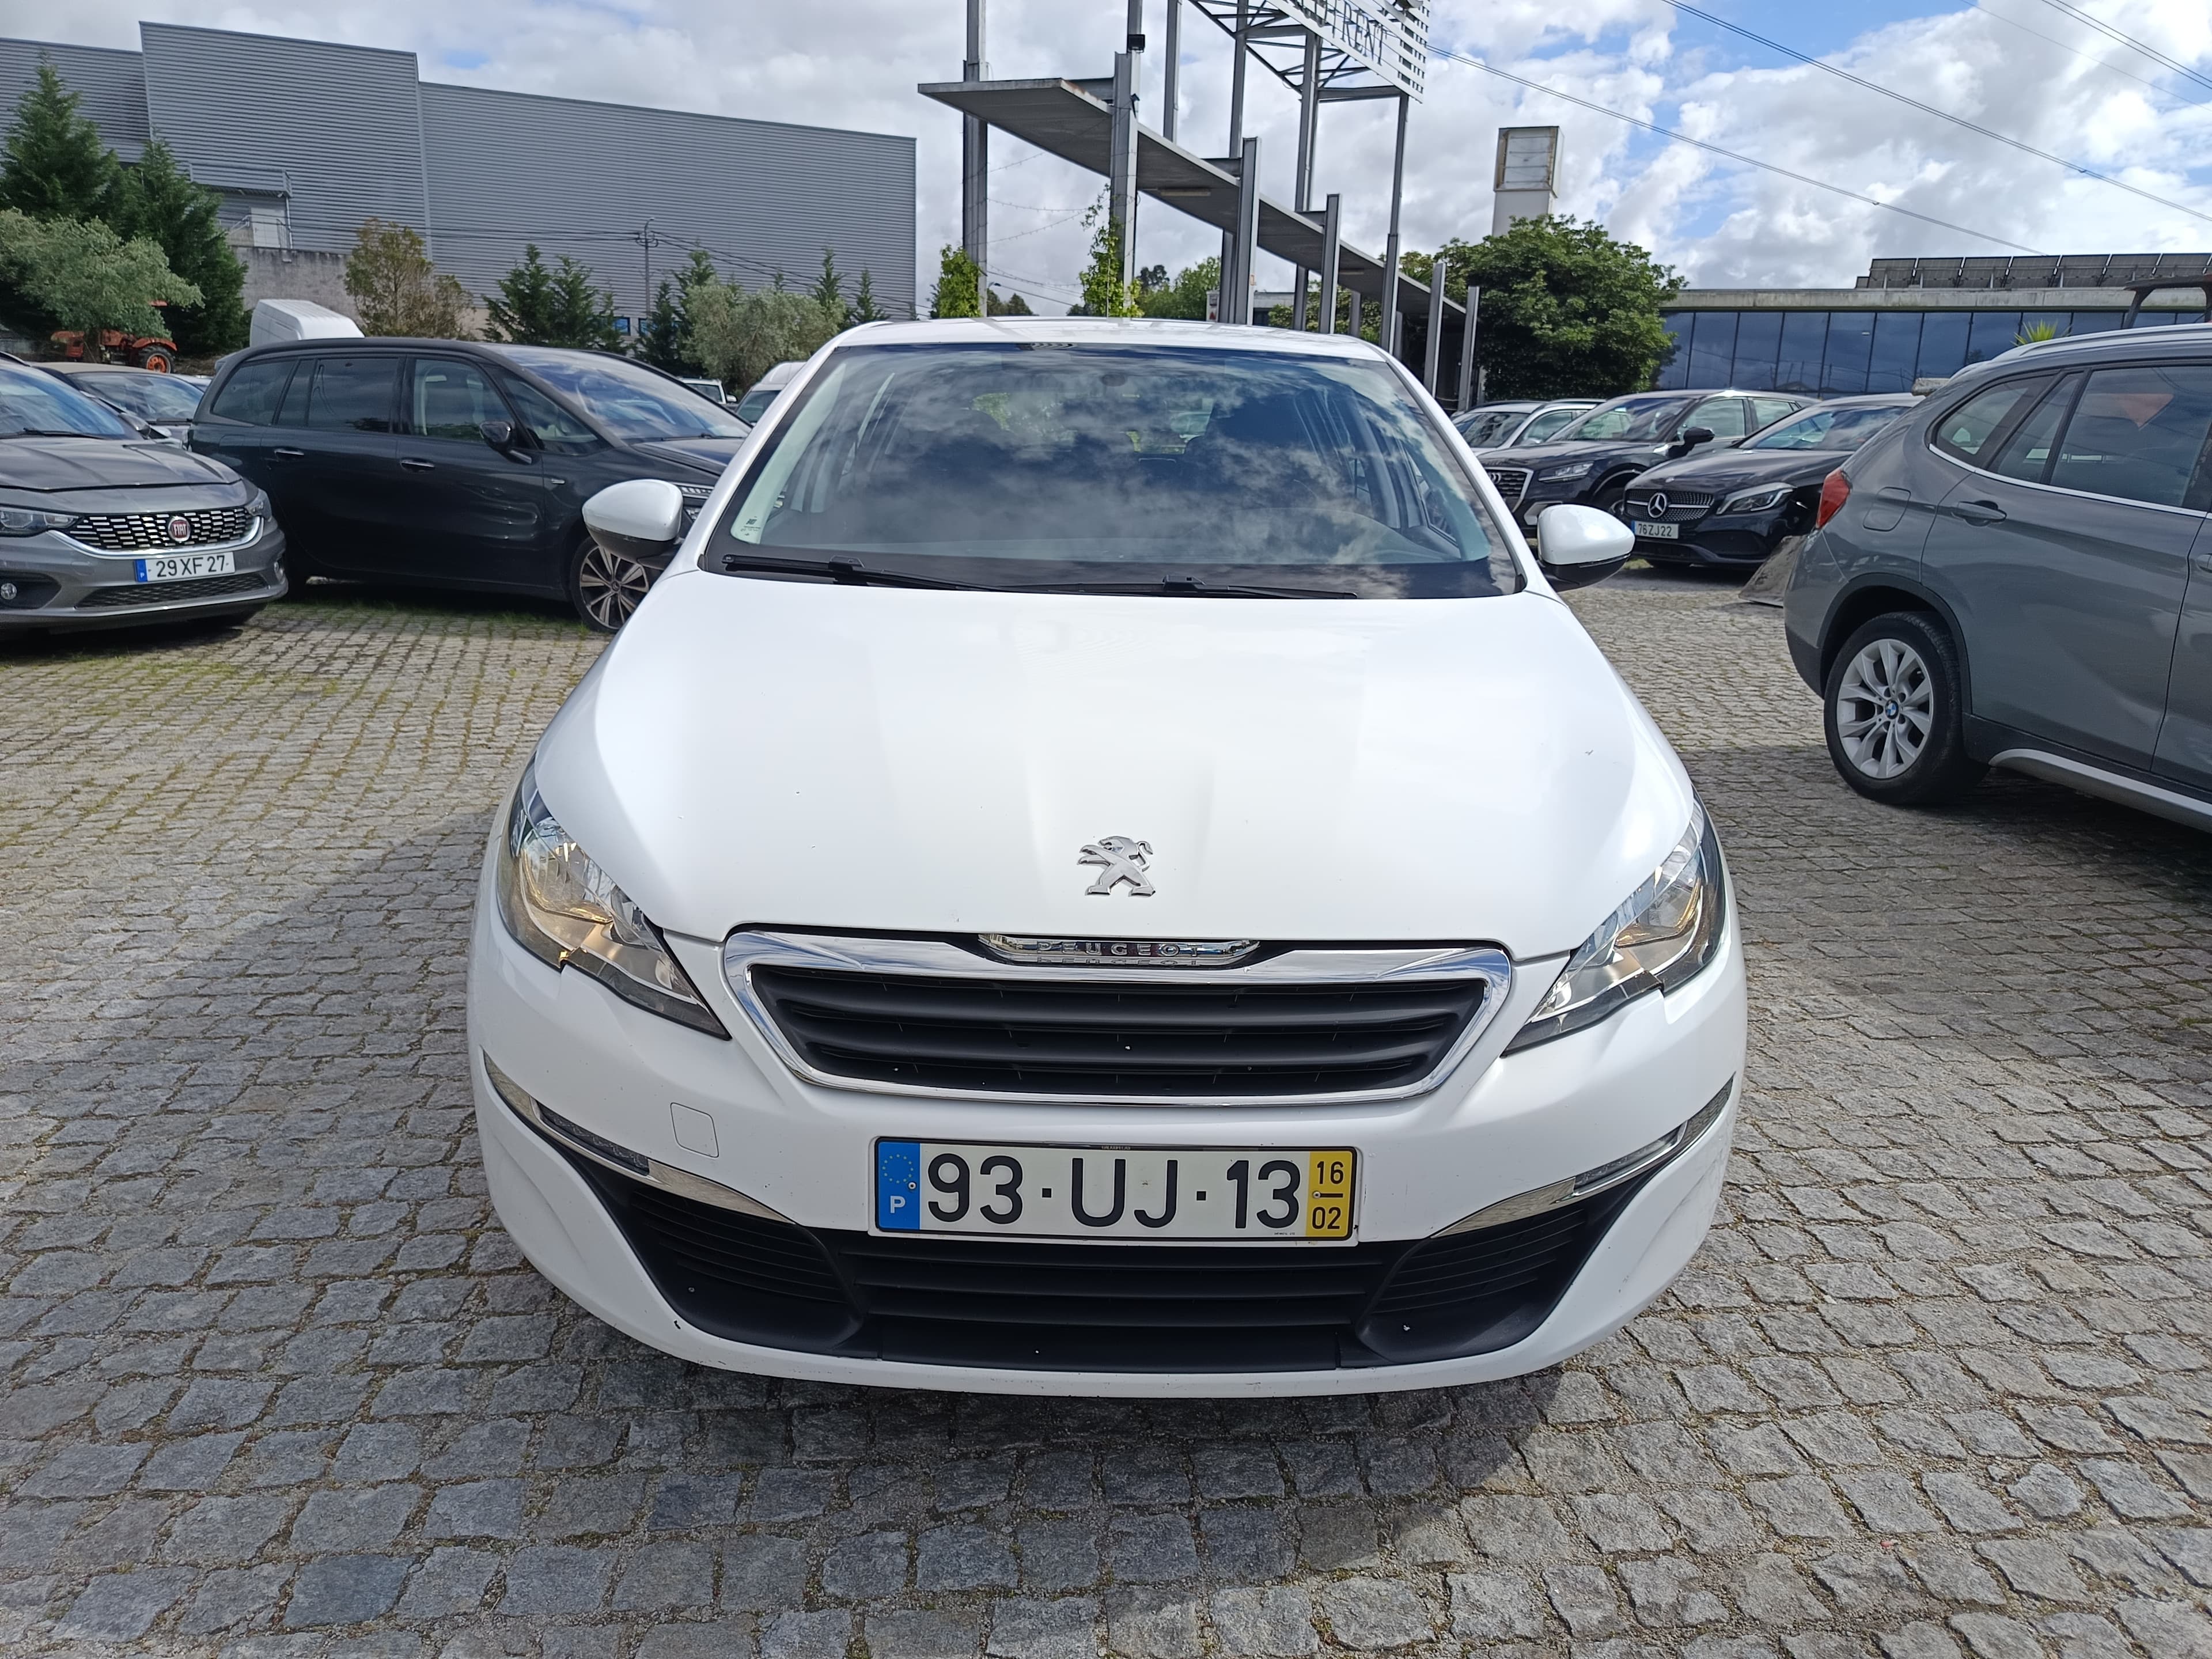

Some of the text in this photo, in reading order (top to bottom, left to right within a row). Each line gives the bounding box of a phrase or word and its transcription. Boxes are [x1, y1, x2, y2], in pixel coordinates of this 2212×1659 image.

[173, 524, 187, 536] FIAT
[1037, 942, 1202, 957] PEUGEOT
[1317, 1161, 1343, 1184] 16
[890, 1196, 906, 1213] P
[1312, 1207, 1341, 1229] 02
